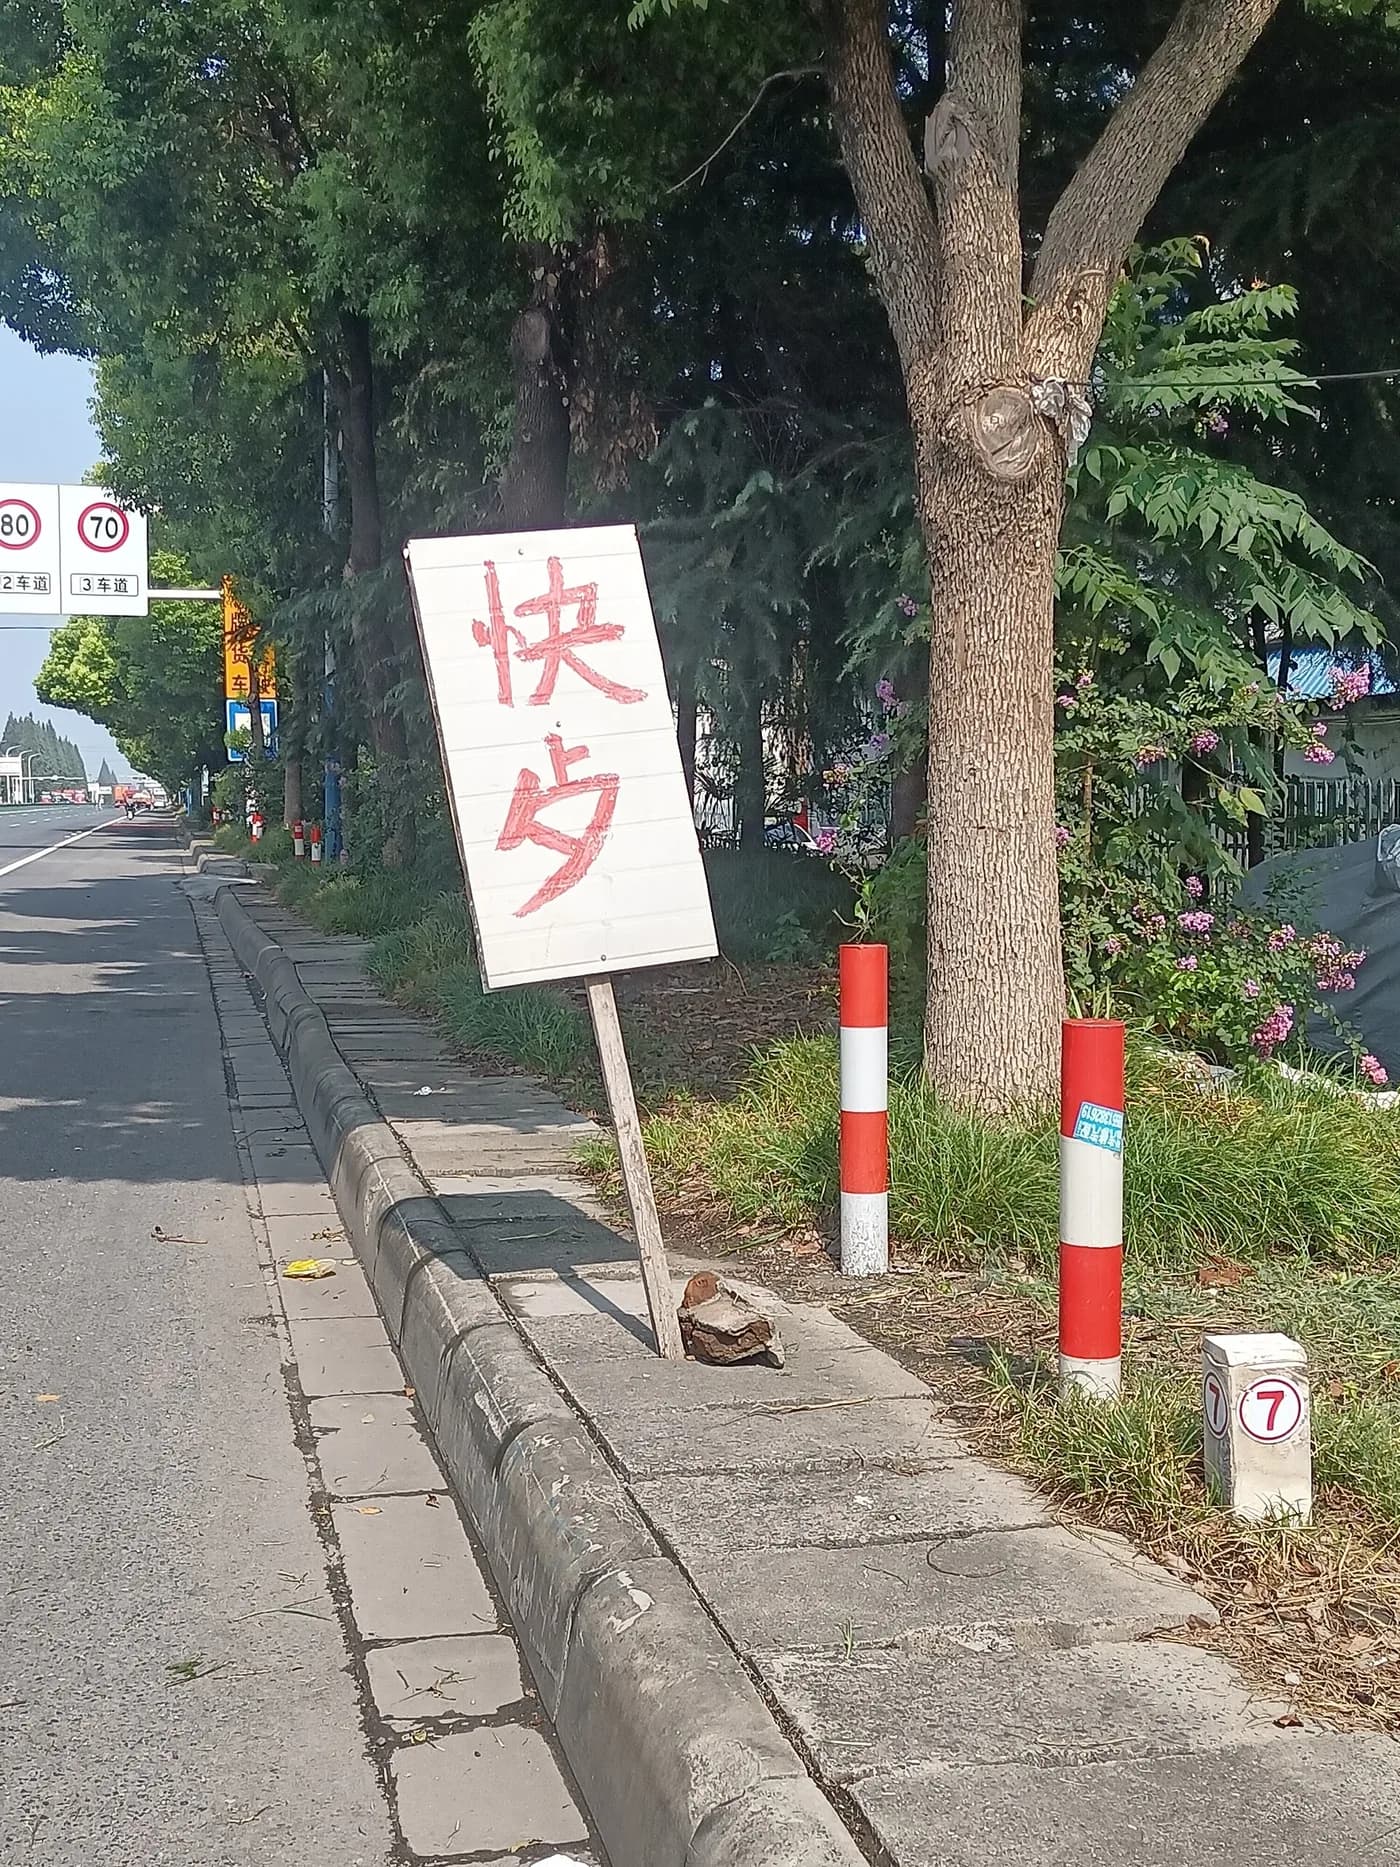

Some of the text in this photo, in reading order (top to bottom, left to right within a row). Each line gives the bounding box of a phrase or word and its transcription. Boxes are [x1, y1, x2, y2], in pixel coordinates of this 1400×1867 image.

[1, 514, 29, 536] 80
[90, 516, 118, 539] 70
[82, 577, 128, 593] 3车道
[1209, 1382, 1221, 1426] 7
[1257, 1390, 1285, 1431] 7
